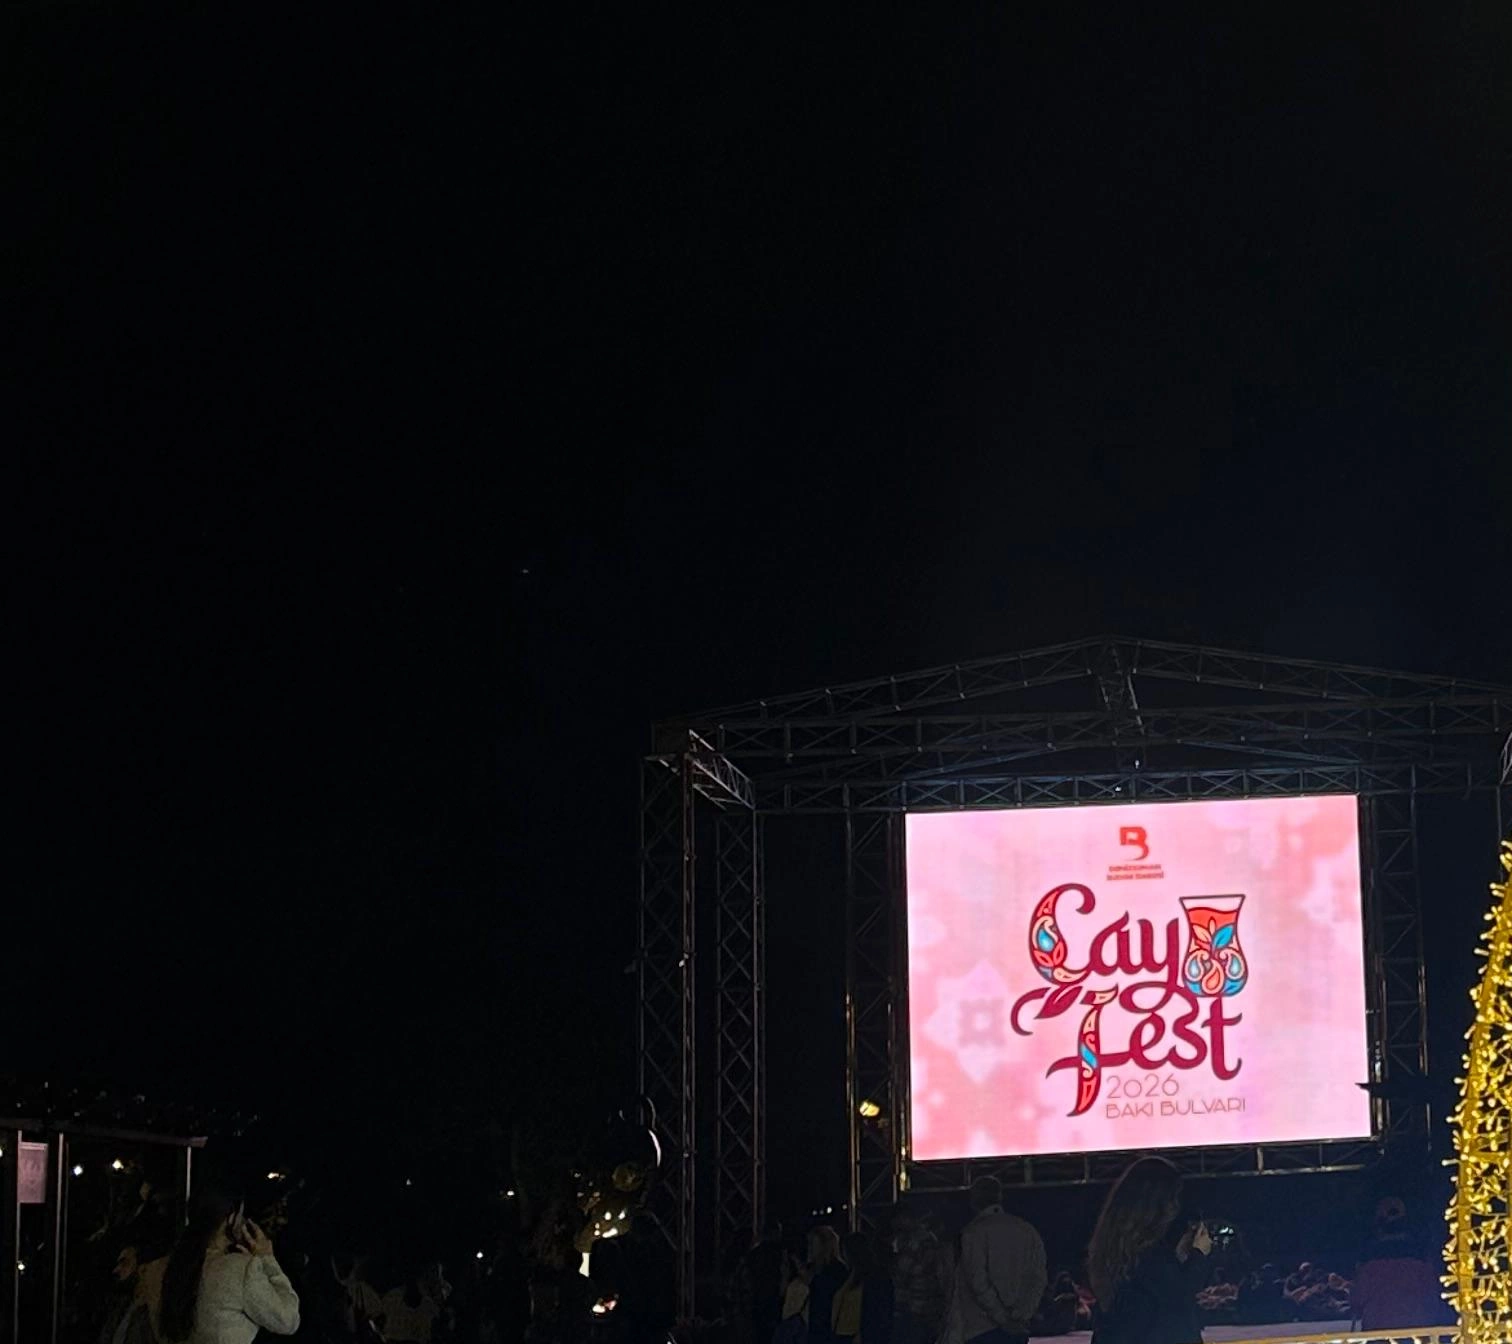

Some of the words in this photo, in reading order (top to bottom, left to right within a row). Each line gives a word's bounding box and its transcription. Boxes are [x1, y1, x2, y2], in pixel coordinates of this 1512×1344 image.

[1045, 984, 1243, 1117] Fest
[1106, 1073, 1180, 1099] 2026
[1106, 1102, 1154, 1119] BAKI
[1160, 1097, 1246, 1117] BULVARI
